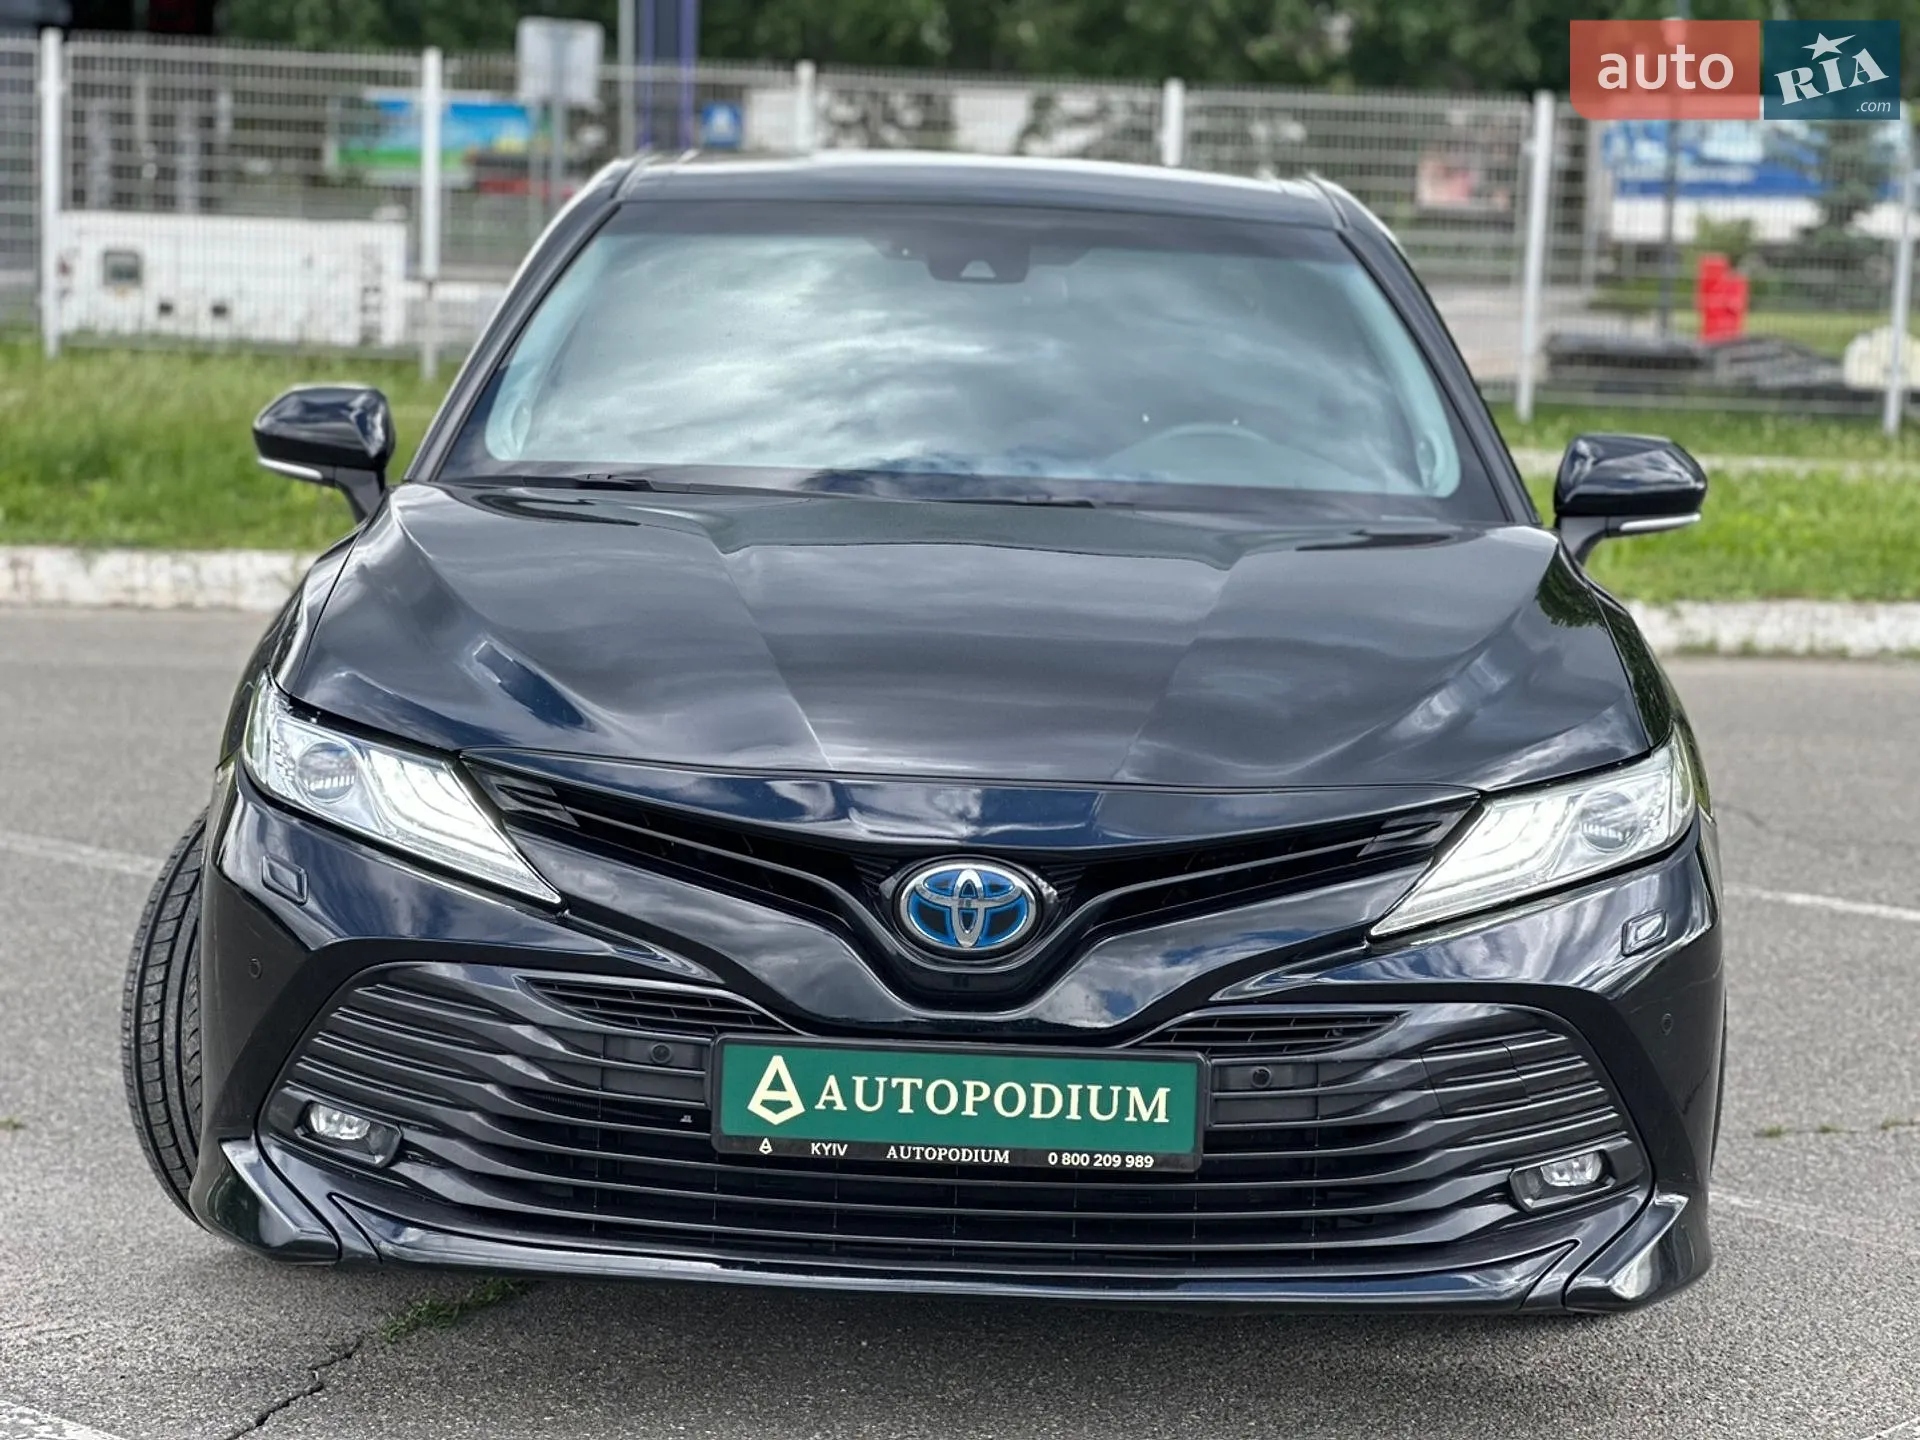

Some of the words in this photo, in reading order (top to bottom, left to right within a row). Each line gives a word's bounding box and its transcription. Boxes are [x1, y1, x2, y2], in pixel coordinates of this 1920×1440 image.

[814, 1074, 1171, 1123] AUTOPODIUM
[810, 1142, 849, 1157] KYIV
[886, 1145, 1010, 1164] AUTOPODIUM
[1047, 1151, 1059, 1166] 0
[1061, 1151, 1091, 1167] 800
[1092, 1153, 1122, 1168] 209
[1124, 1154, 1155, 1169] 989
